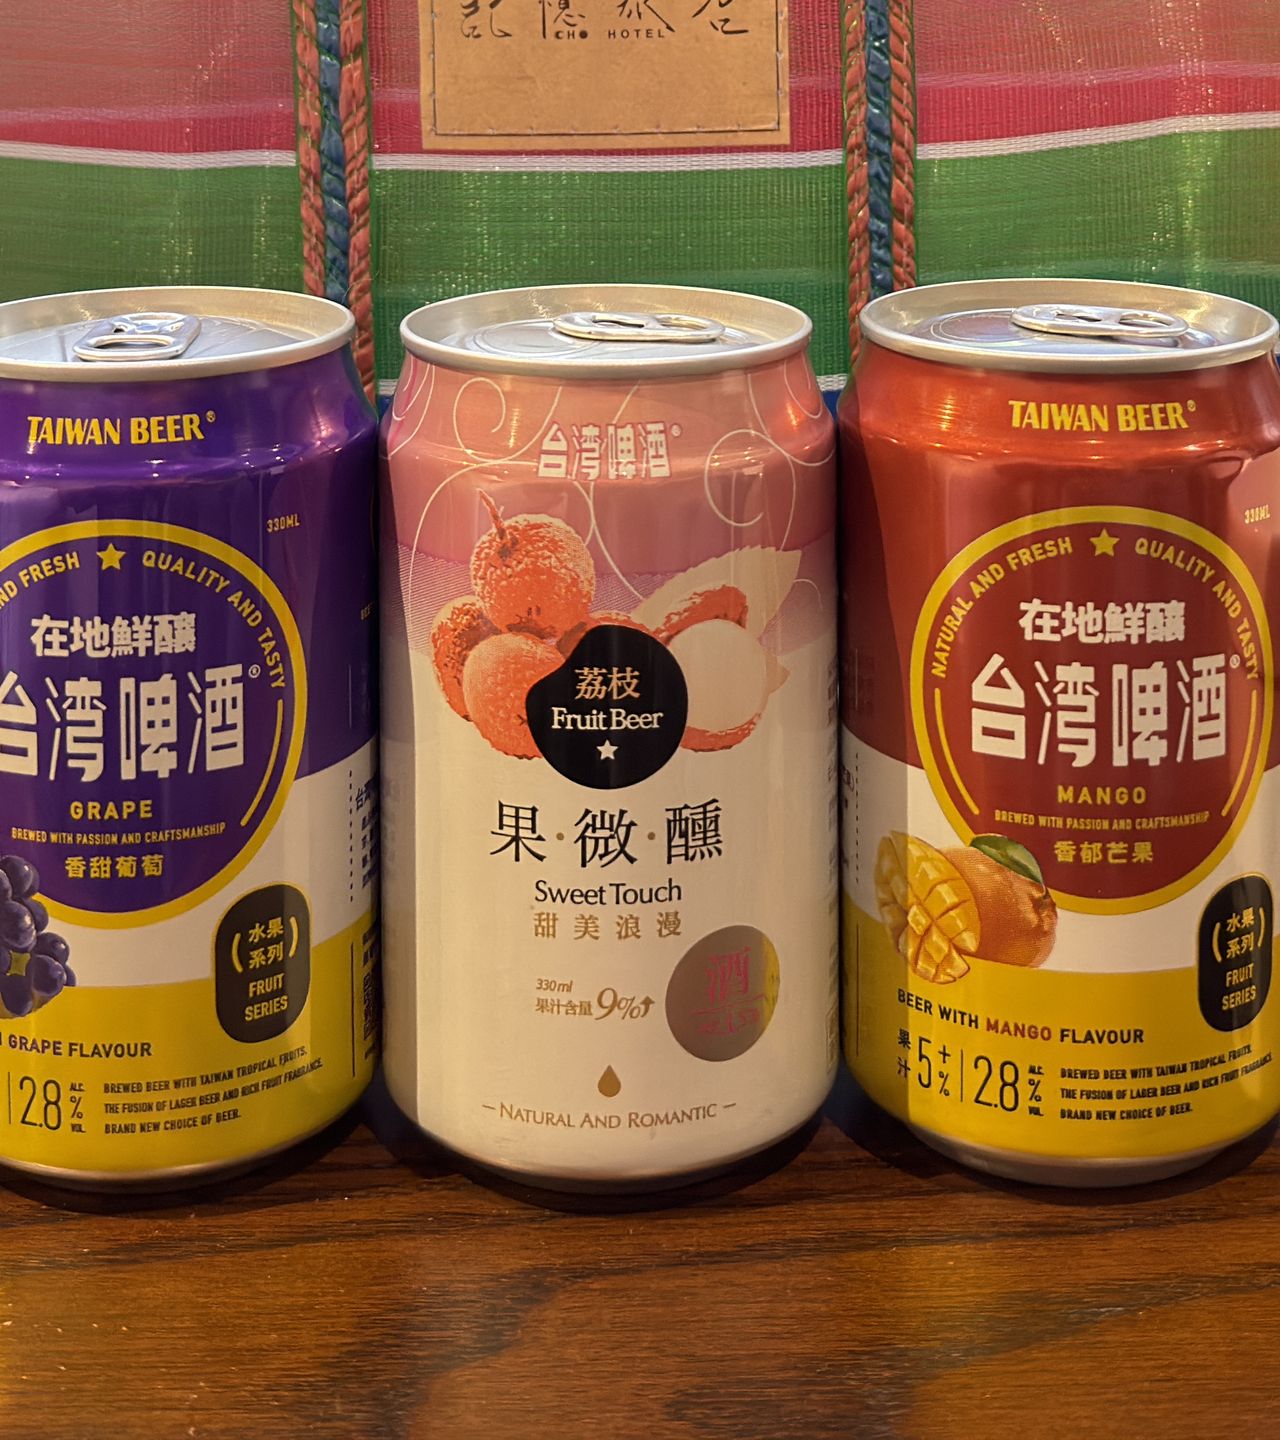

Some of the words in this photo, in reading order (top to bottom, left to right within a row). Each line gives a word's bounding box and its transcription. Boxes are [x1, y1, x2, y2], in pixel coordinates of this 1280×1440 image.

[608, 27, 666, 40] HOTEL
[27, 416, 120, 445] TAIWAN
[130, 413, 205, 445] BEER
[1008, 400, 1109, 432] TAIWAN
[1117, 401, 1189, 431] BEER
[266, 513, 300, 533] 330ML
[19, 551, 80, 588] FRESH
[142, 550, 230, 594] QUALITY
[228, 590, 263, 628] AND
[257, 626, 287, 690] TASTY
[931, 596, 974, 678] NATURAL
[968, 562, 1006, 599] AND
[1006, 536, 1073, 572] FRESH
[1134, 537, 1216, 584] QUALITY
[1211, 579, 1244, 619] AND
[1235, 616, 1259, 680] TASTY
[1018, 597, 1186, 645] 在地鮮釀
[30, 612, 197, 659] 在地鮮釀
[574, 666, 641, 701] 荔枝
[551, 706, 607, 730] Fruit
[610, 707, 664, 730] Beer
[1057, 785, 1147, 805] MANGO
[70, 799, 153, 821] GRAPE
[994, 809, 1035, 826] BREWED
[1038, 815, 1063, 829] WITH
[1066, 817, 1110, 831] PASSION
[1112, 817, 1132, 831] AND
[1135, 810, 1210, 830] CRAFTSMANSHIP
[11, 826, 48, 843] BREWED
[50, 831, 73, 844] WITH
[76, 832, 119, 846] PASSION
[121, 831, 141, 845] AND
[145, 822, 226, 843] CRAFTSMANSHIP
[1054, 840, 1154, 864] 香郁芒果
[64, 853, 165, 879] 香甜葡萄
[534, 879, 606, 905] Sweet
[609, 878, 683, 905] Touch
[248, 916, 285, 944] 水果
[532, 911, 683, 941] 甜美浪漫
[1226, 906, 1255, 933] 水果
[248, 943, 284, 970] 系列
[1226, 931, 1254, 959] 系列
[248, 972, 285, 998] FRUIT
[1225, 962, 1254, 988] FRUIT
[244, 994, 288, 1022] SERIES
[1222, 985, 1257, 1011] SERIES
[897, 988, 933, 1015] BEER
[938, 1004, 979, 1029] WITH
[985, 1017, 1052, 1041] MANGO
[1060, 1028, 1144, 1045] FLAVOUR
[8, 1034, 63, 1056] GRAPE
[68, 1041, 153, 1058] FLAVOUR
[103, 1081, 144, 1094] BREWED
[145, 1080, 170, 1092] BEER
[173, 1076, 197, 1090] WITH
[199, 1069, 234, 1087] TAIWAN
[236, 1056, 277, 1080] TROPICAL
[918, 1035, 932, 1089] 5
[1060, 1067, 1100, 1080] BREWED
[1103, 1068, 1127, 1080] BEER
[1130, 1066, 1153, 1079] WITH
[1156, 1061, 1187, 1077] TAIWAN
[1189, 1053, 1226, 1074] TROPICAL
[103, 1103, 120, 1114] THE
[122, 1101, 154, 1115] FUSION
[155, 1100, 168, 1112] OF
[199, 1094, 221, 1108] BEER
[222, 1088, 240, 1104] AND
[241, 1083, 260, 1099] RICH
[261, 1076, 283, 1094] FRUIT
[973, 1054, 1020, 1112] 2.8
[1060, 1087, 1077, 1099] THE
[1080, 1088, 1113, 1100] FUSION
[1116, 1088, 1127, 1100] OF
[1160, 1084, 1181, 1097] BEER
[1183, 1080, 1200, 1093] AND
[19, 1075, 62, 1132] 2.8
[1060, 1108, 1093, 1120] BRAND
[1095, 1109, 1116, 1121] NEW
[1120, 1108, 1153, 1120] CHOICE
[1156, 1106, 1167, 1118] OF
[104, 1122, 138, 1135] BRAND
[139, 1120, 161, 1133] NEW
[163, 1116, 199, 1130] CHOICE
[201, 1113, 215, 1127] OF
